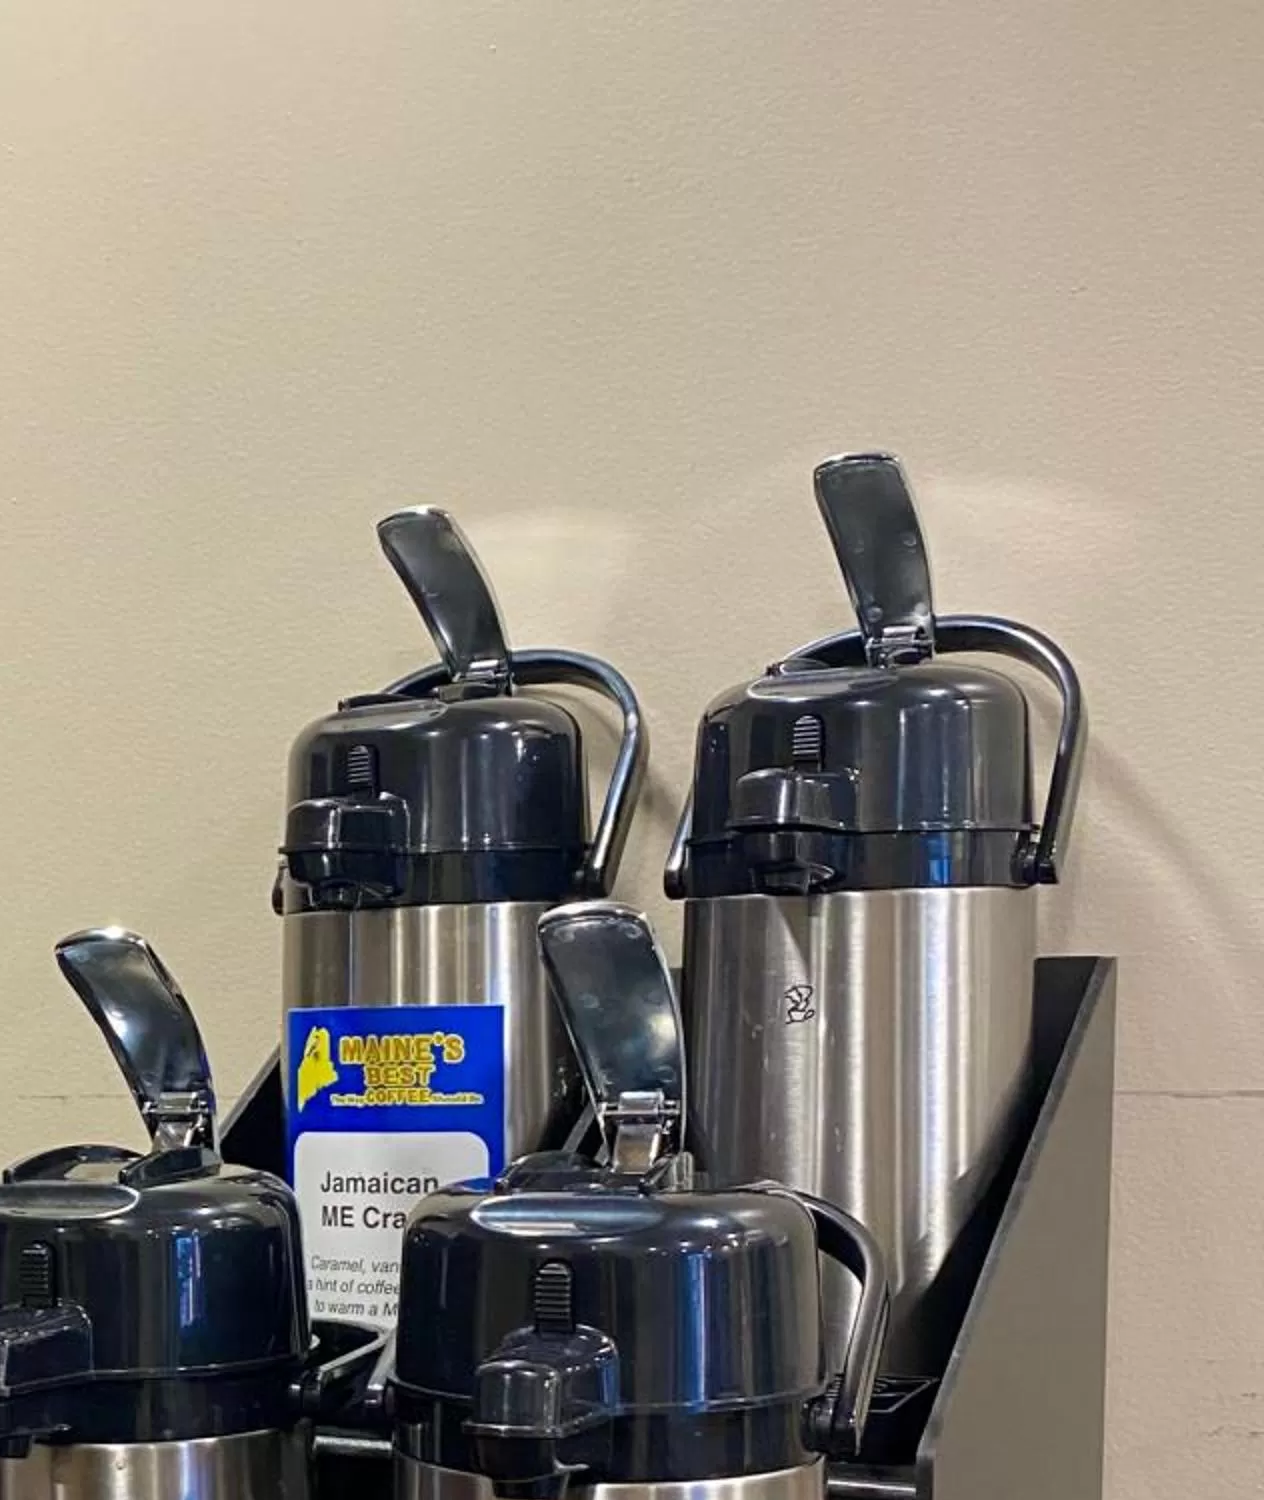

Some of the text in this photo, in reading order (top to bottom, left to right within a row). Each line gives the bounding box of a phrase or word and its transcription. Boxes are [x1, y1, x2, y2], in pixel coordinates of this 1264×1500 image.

[340, 1033, 465, 1064] MAINE'S
[365, 1064, 435, 1087] BEST
[365, 1088, 431, 1105] COFFEE
[321, 1171, 439, 1195] Jamaican
[322, 1206, 406, 1228] ME Cra
[311, 1254, 399, 1275] Caramel, van
[316, 1278, 337, 1292] hint
[340, 1280, 354, 1293] of
[328, 1303, 364, 1315] warm
[368, 1304, 378, 1316] a
